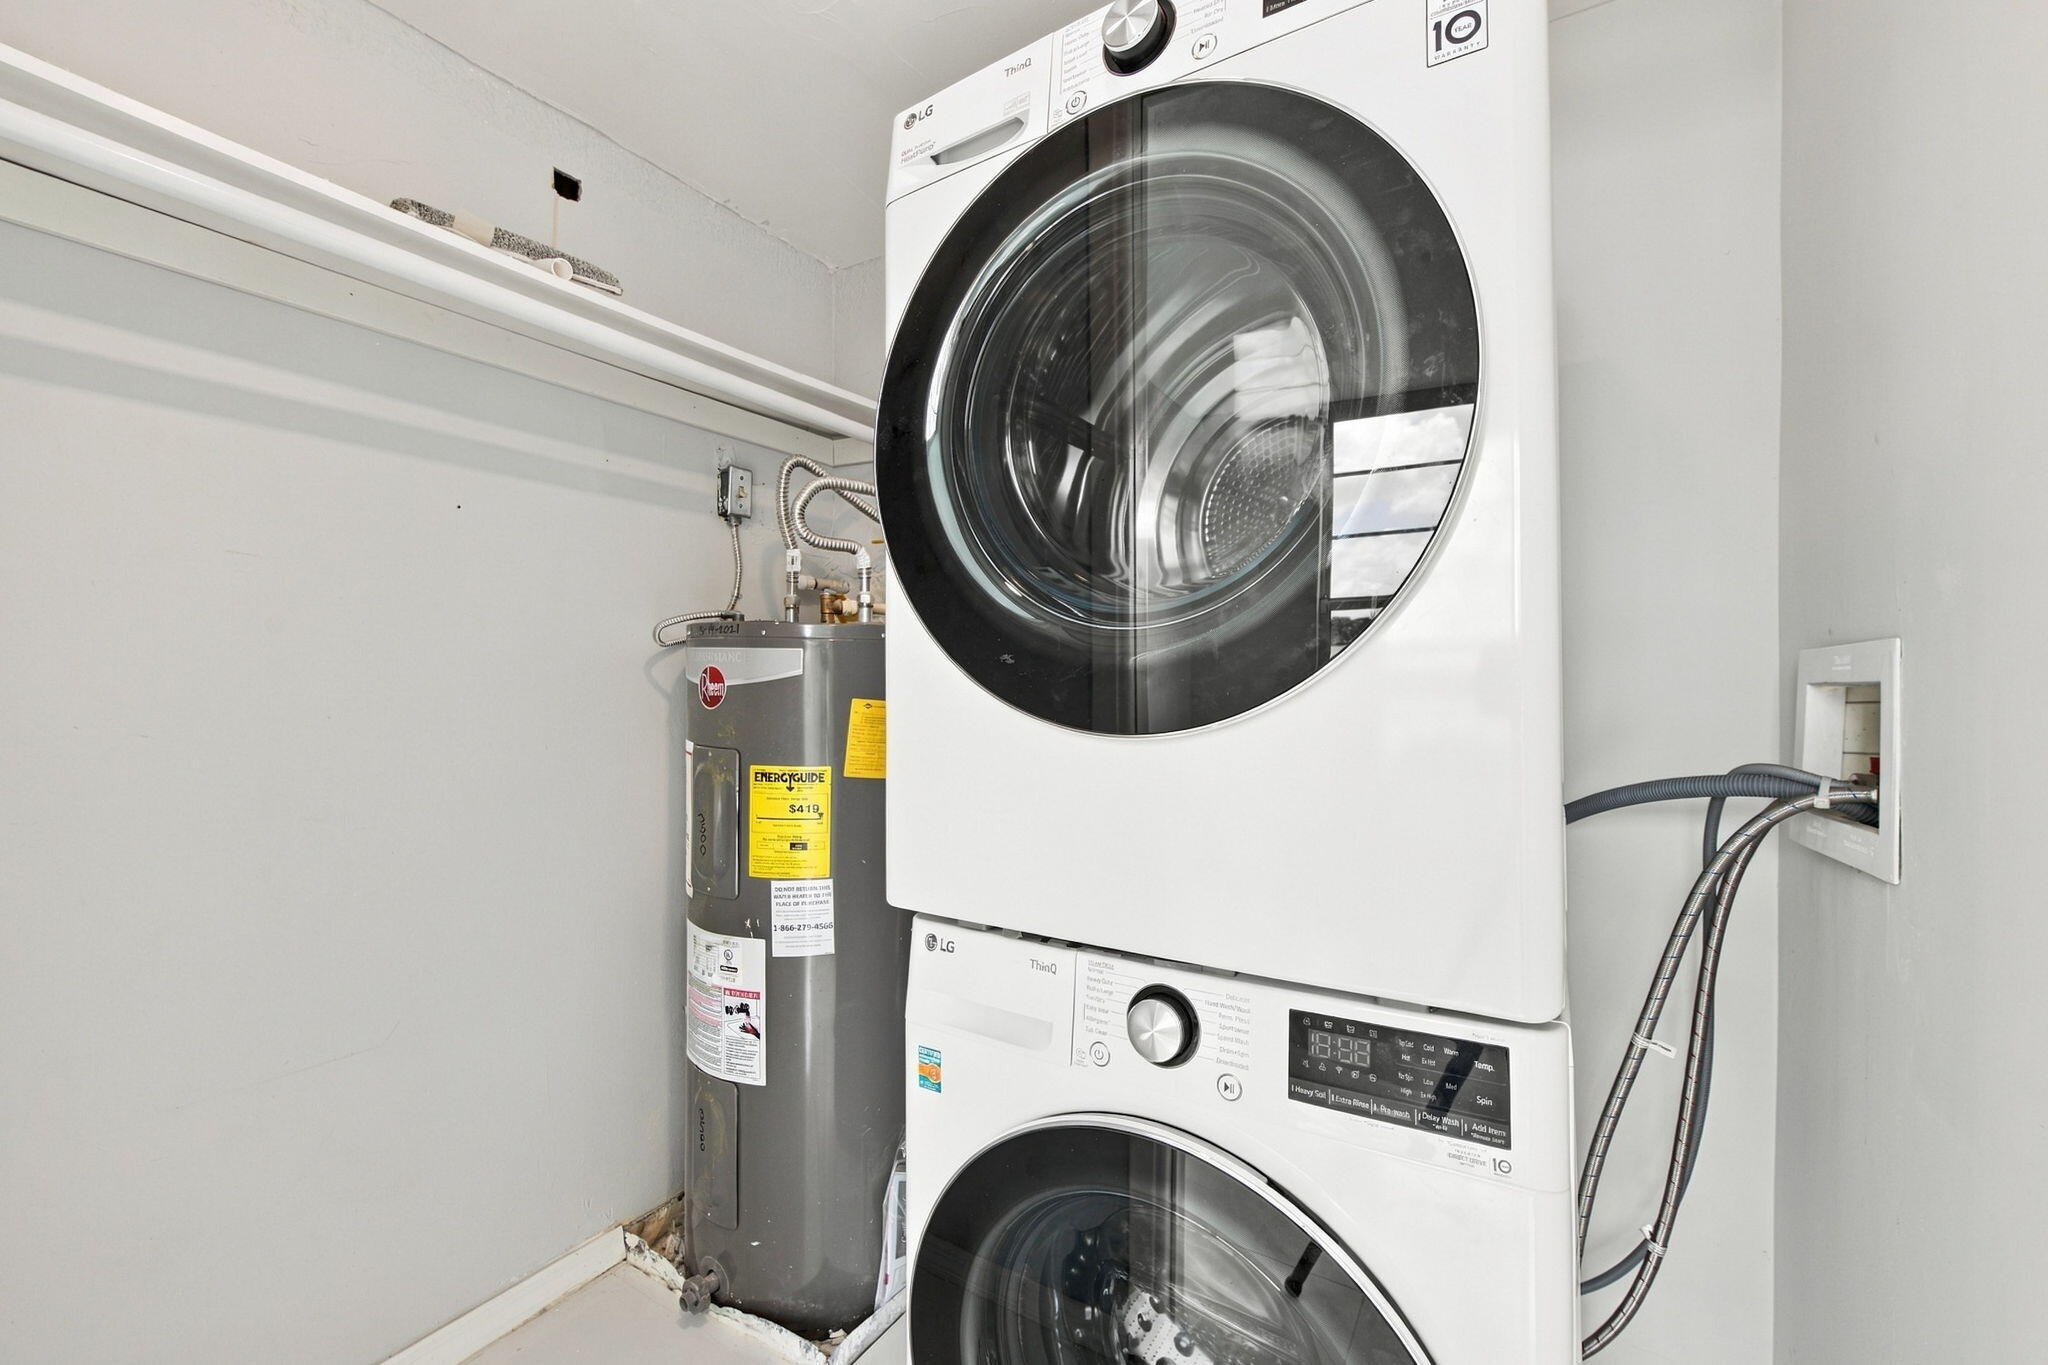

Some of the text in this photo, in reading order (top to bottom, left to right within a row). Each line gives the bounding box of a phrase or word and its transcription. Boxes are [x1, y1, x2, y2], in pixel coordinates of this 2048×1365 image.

[1433, 10, 1482, 52] 10
[1454, 22, 1473, 33] YEAR
[1434, 41, 1481, 61] WARRANTY
[1004, 57, 1032, 78] ThinQ
[919, 104, 933, 121] LG
[701, 667, 724, 702] Rheem
[754, 772, 825, 784] ENERGYGUIDE
[789, 804, 820, 814] $419
[773, 922, 834, 932] 1-866-279-4566
[940, 938, 955, 954] LG
[1030, 958, 1057, 975] ThinQ
[1423, 1043, 1435, 1053] Cold
[1443, 1047, 1460, 1057] Warm
[1401, 1054, 1411, 1062] Hot
[1427, 1059, 1436, 1067] Hot
[1473, 1060, 1495, 1072] Temp.
[1423, 1078, 1434, 1086] Low
[1445, 1082, 1457, 1091] Med
[1295, 1085, 1327, 1099] Heavy Soil
[1400, 1087, 1413, 1097] High
[1335, 1095, 1370, 1109] Extra Rinse
[1476, 1095, 1493, 1106] Spin
[1422, 1111, 1460, 1128] Delay Wash
[1472, 1122, 1506, 1137] Add Item
